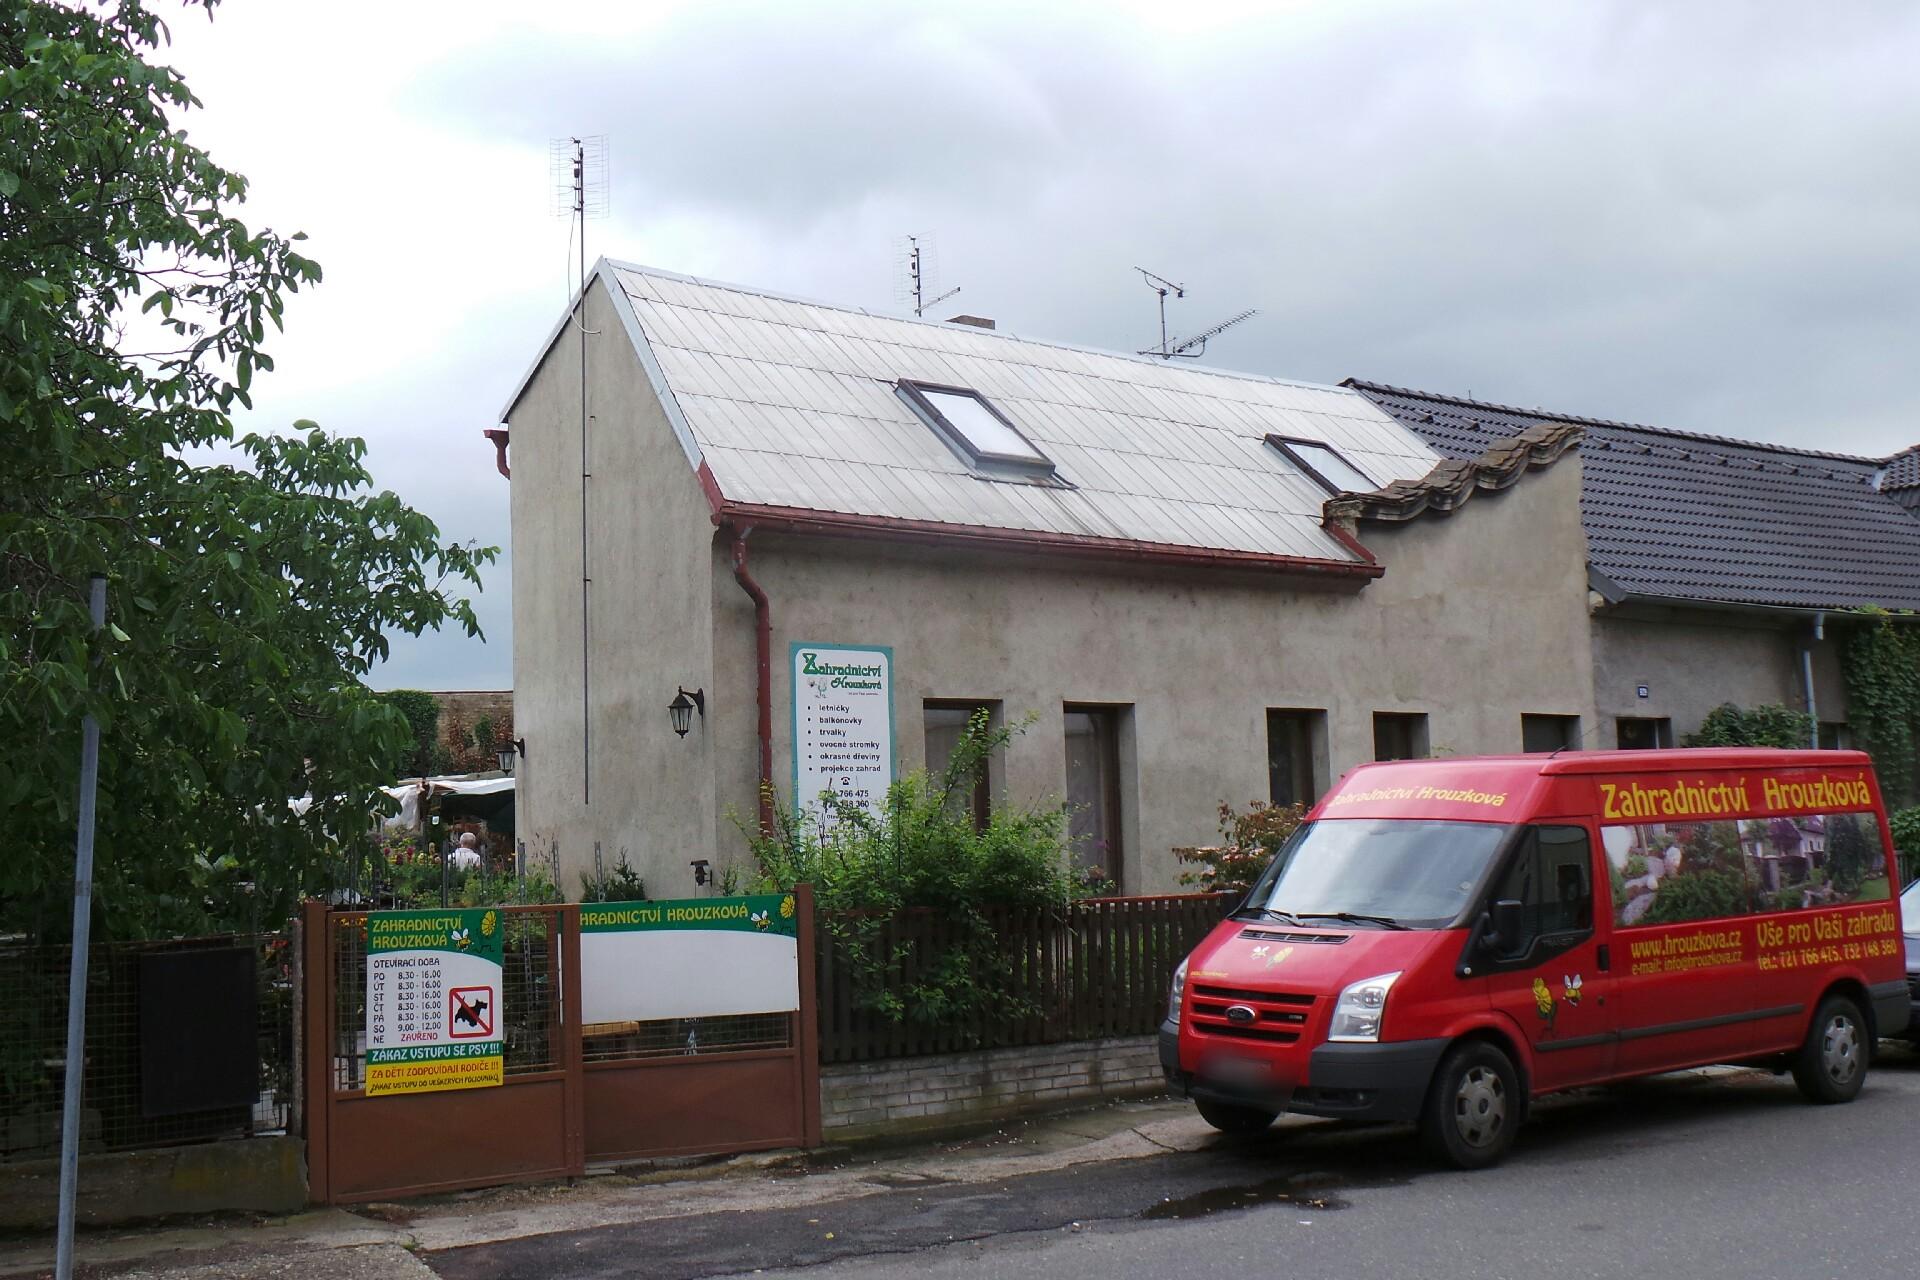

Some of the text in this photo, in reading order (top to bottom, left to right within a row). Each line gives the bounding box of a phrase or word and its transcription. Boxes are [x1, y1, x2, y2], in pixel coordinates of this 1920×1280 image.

[802, 653, 881, 677] Zahradnictví
[819, 729, 847, 737] trvalky
[849, 741, 880, 750] stromky
[853, 752, 881, 762] dřeviny
[820, 764, 881, 773] projekce zahrad
[839, 790, 854, 798] 766
[855, 790, 869, 798] 475
[1416, 786, 1508, 807] Hrouzková
[1600, 772, 1872, 819] Zahradnictví Hrouzková
[667, 901, 749, 921] HROUZKOVÁ
[372, 915, 462, 933] ZAHRADNICTVÍ
[1757, 909, 1896, 948] Vše pro Vaši zahradu
[372, 931, 448, 949] HROUZKOVÁ
[1631, 931, 1742, 959] www.hrouzkova.cz
[374, 957, 440, 968] OTEVÍRACÍ DOBA
[1779, 949, 1798, 968] 721
[1801, 947, 1819, 966] 766
[1632, 958, 1662, 976] e-mail:
[374, 972, 385, 980] PO
[398, 971, 414, 980] 8.30
[421, 970, 441, 978] 16.00
[398, 982, 414, 990] 8.30
[421, 980, 441, 989] 16.00
[374, 993, 385, 1001] ST
[398, 992, 414, 1000] 8.30
[421, 990, 441, 999] 16.00
[398, 1002, 414, 1010] 8.30
[421, 1000, 441, 1009] 16.00
[398, 1012, 414, 1021] 8.30
[421, 1011, 441, 1020] 16.00
[374, 1024, 385, 1033] SO
[398, 1023, 414, 1032] 9.00
[421, 1021, 441, 1030] 12.00
[374, 1031, 438, 1044] NE ZAVŘENO
[372, 1047, 408, 1062] ZÁKAZ
[410, 1046, 451, 1059] VSTUPU
[453, 1045, 466, 1056] SE
[469, 1044, 488, 1055] PSY
[372, 1070, 383, 1079] ZA
[385, 1067, 404, 1078] DĚTI
[461, 1061, 489, 1073] RODIČE
